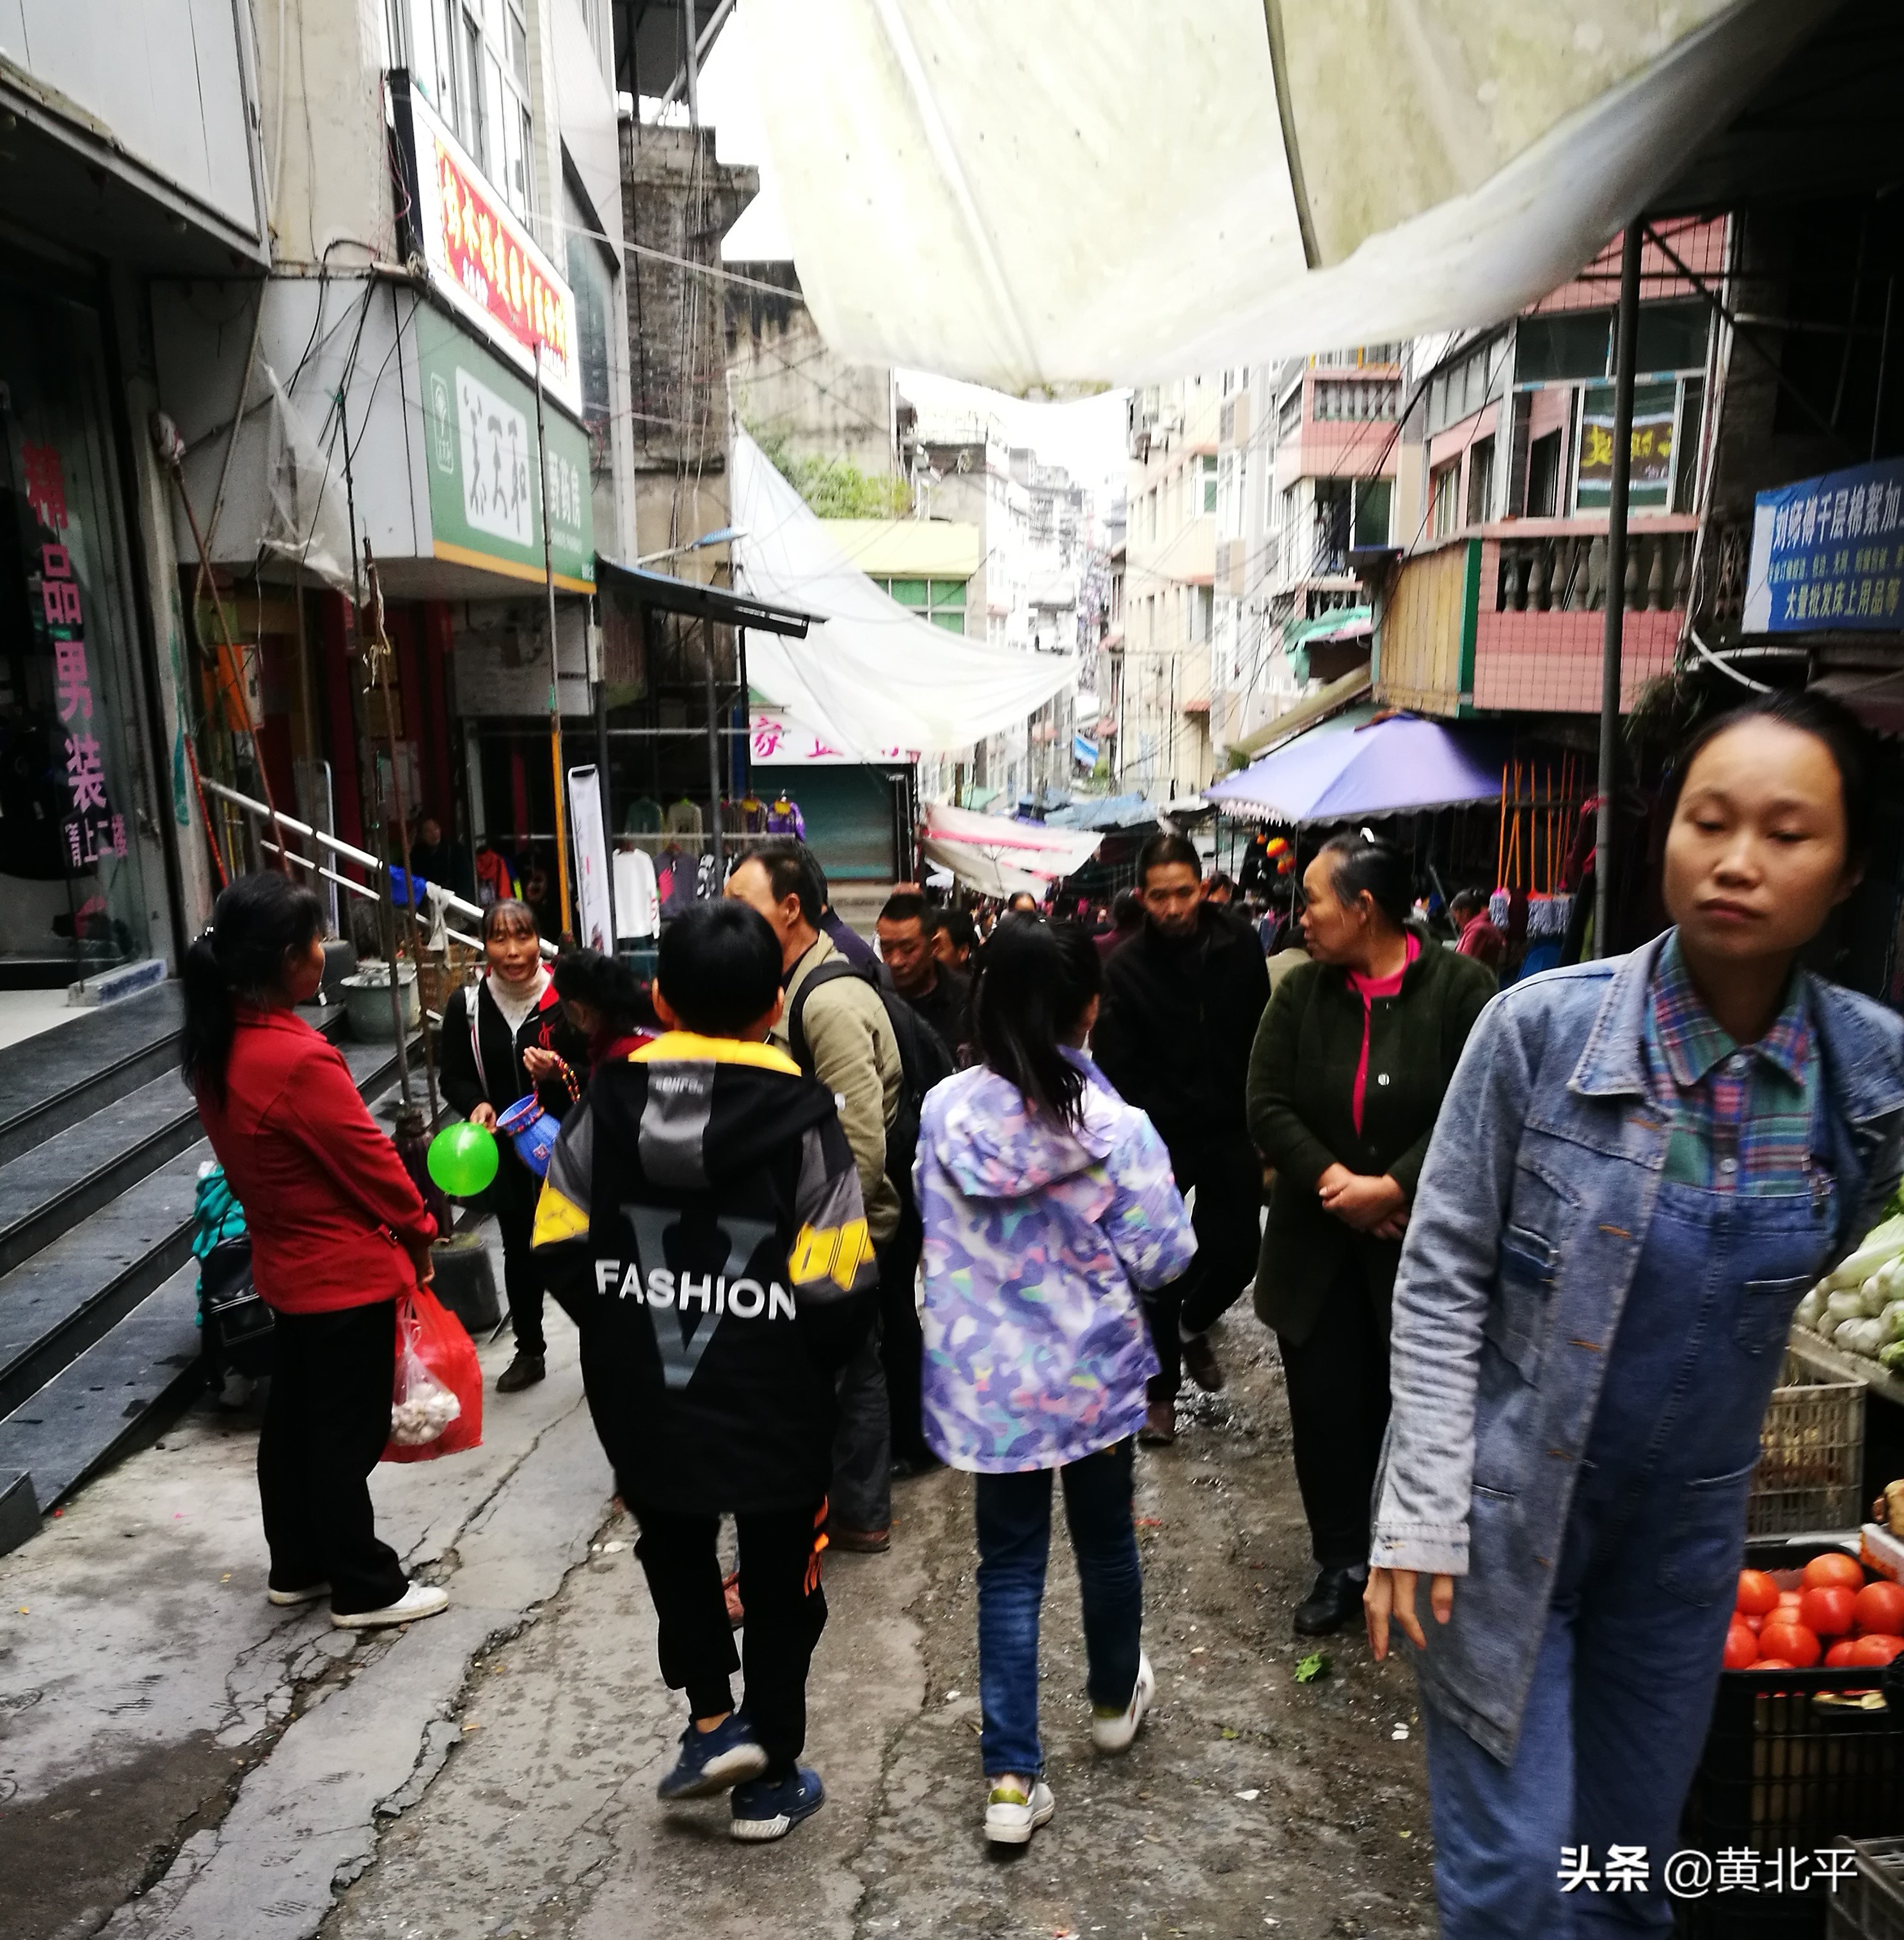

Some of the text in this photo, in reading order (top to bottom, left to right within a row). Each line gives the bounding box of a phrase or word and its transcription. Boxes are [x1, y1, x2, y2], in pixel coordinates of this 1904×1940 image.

[1773, 478, 1904, 551] 刘师傅千层棉絮加
[21, 438, 107, 814] 精品男装
[595, 1259, 797, 1321] FASHION
